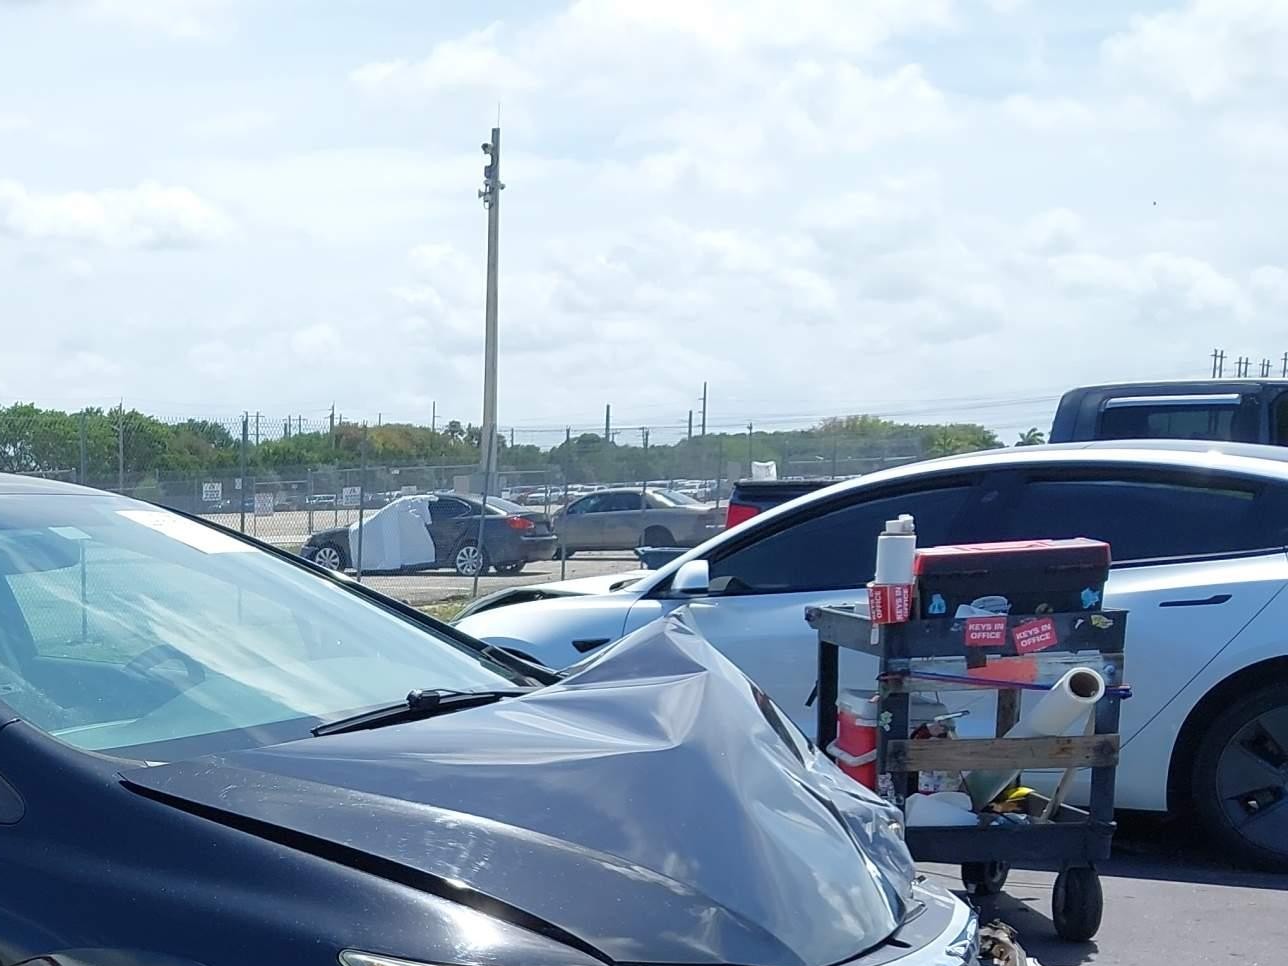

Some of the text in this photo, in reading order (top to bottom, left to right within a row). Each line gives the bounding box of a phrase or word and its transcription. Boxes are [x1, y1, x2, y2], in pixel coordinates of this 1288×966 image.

[874, 590, 882, 619] OFFICE
[895, 598, 904, 621] KEYS
[968, 623, 992, 631] KEYS
[1015, 623, 1052, 640] KEYS IN
[970, 631, 1002, 640] OFFICE
[1020, 632, 1051, 647] OFFICE
